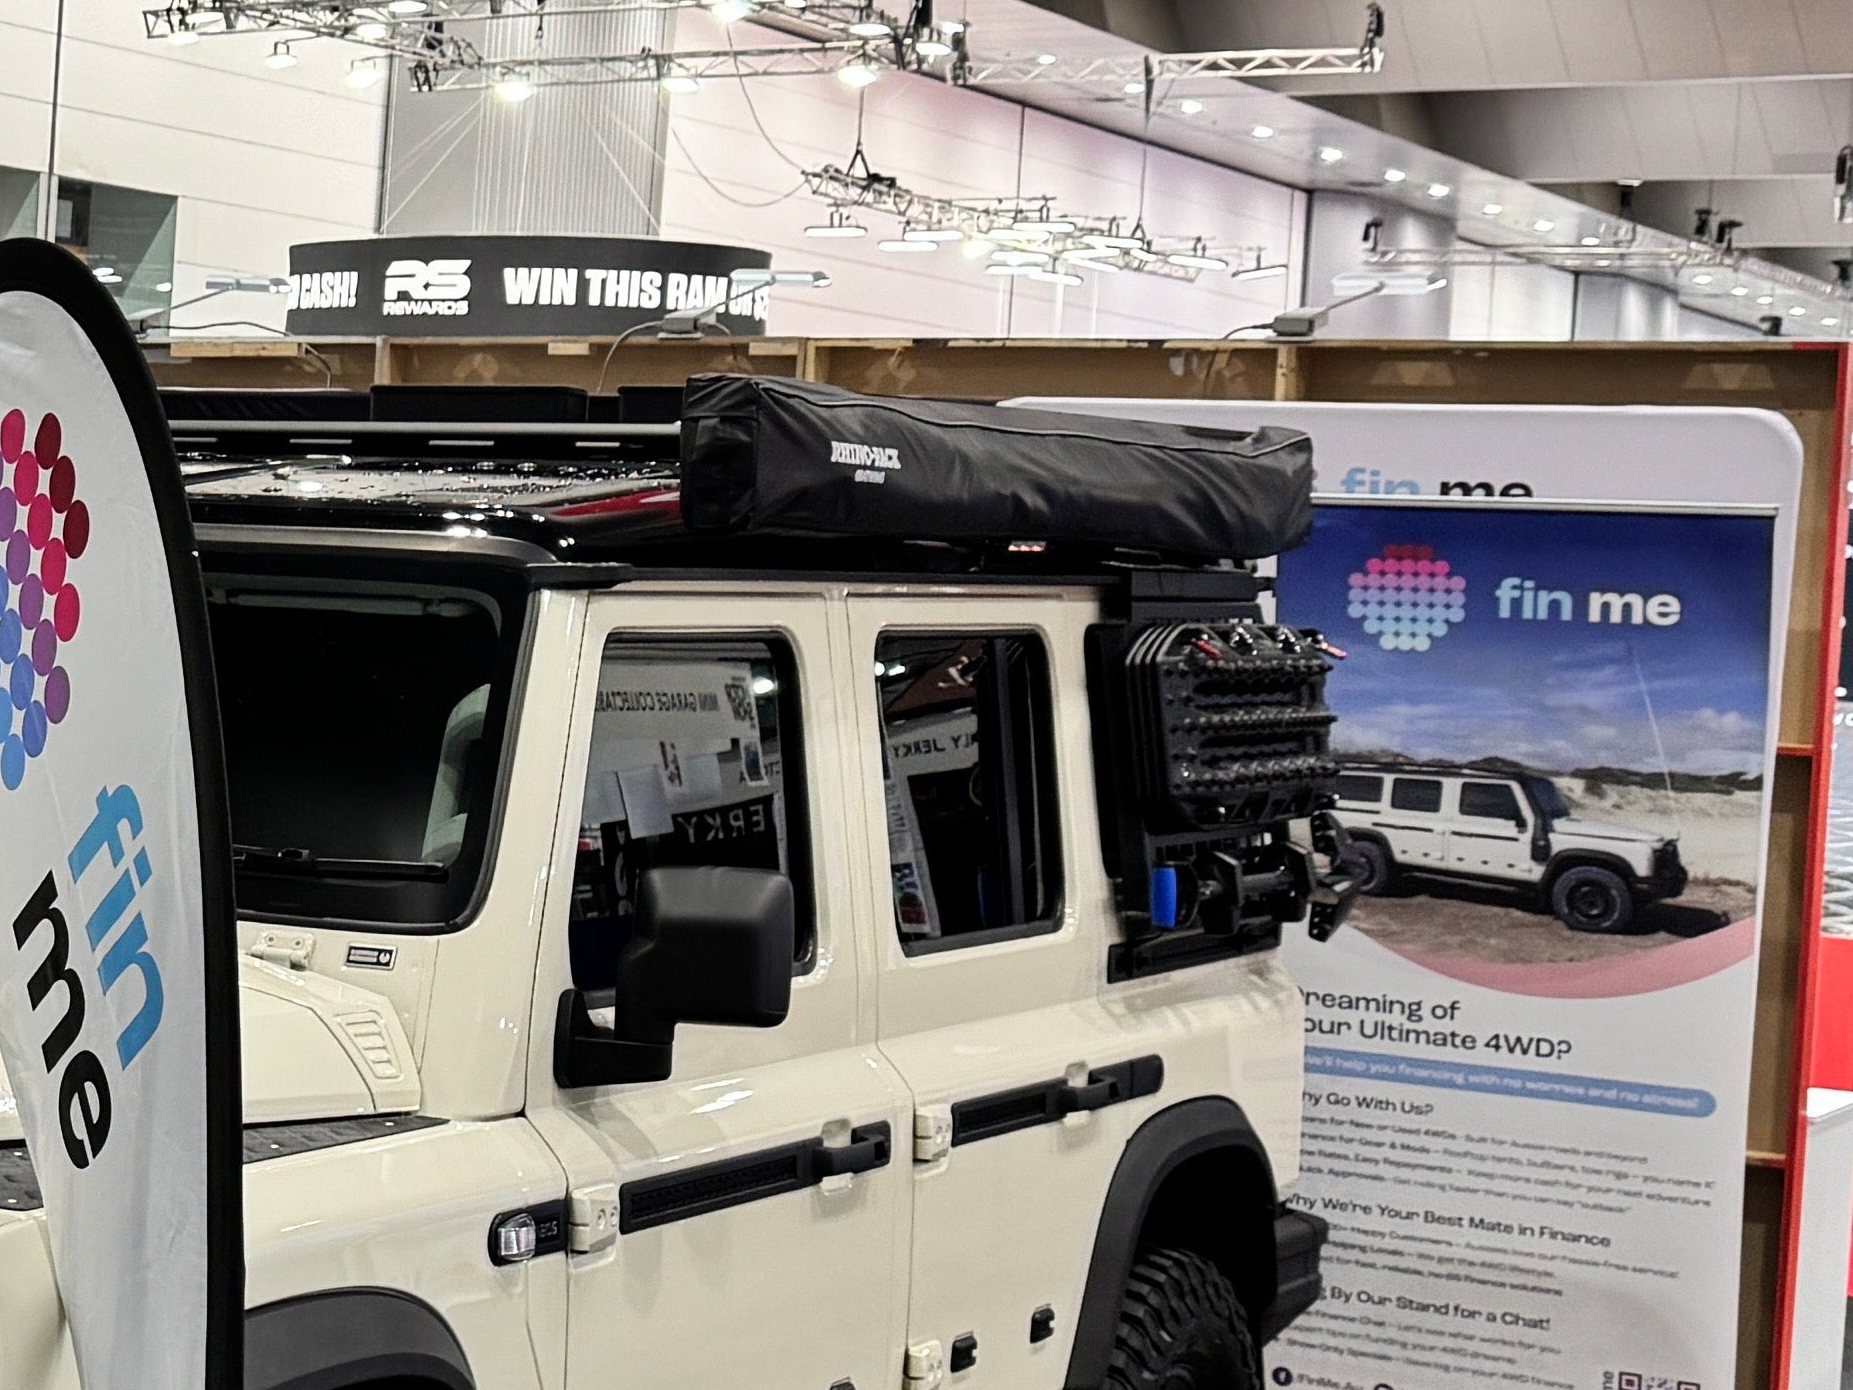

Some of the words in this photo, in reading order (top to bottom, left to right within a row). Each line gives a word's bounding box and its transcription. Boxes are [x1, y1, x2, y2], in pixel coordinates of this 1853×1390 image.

[299, 270, 359, 309] CASH!
[384, 259, 472, 301] RS
[503, 267, 578, 306] WIN
[584, 268, 663, 309] THIS
[666, 272, 728, 314] RAM
[383, 300, 469, 316] REWARDS
[1341, 467, 1420, 496] fin
[1439, 478, 1534, 499] me
[1496, 577, 1572, 621] fin
[1588, 590, 1682, 626] me
[67, 784, 165, 1071] fin
[12, 869, 112, 1170] me
[1431, 999, 1461, 1021] of
[1304, 1017, 1352, 1035] our
[1359, 1018, 1477, 1051] Ultimate
[1484, 1033, 1572, 1061] 4WD?
[1370, 1063, 1396, 1074] you
[1588, 1086, 1617, 1099] and
[1302, 1090, 1323, 1108] hy
[1326, 1092, 1351, 1107] Go
[1355, 1095, 1397, 1113] With
[1401, 1101, 1434, 1116] Us?
[1321, 1197, 1373, 1216] We're
[1376, 1204, 1421, 1220] Your
[1423, 1210, 1464, 1228] Best
[1468, 1216, 1514, 1236] Mate
[1517, 1223, 1535, 1238] in
[1539, 1225, 1611, 1248] Finance
[1330, 1286, 1354, 1305] By
[1356, 1290, 1393, 1306] Our
[1396, 1295, 1450, 1316] Stand
[1453, 1303, 1483, 1321] for
[1485, 1311, 1497, 1323] a
[1500, 1311, 1551, 1331] Chat!
